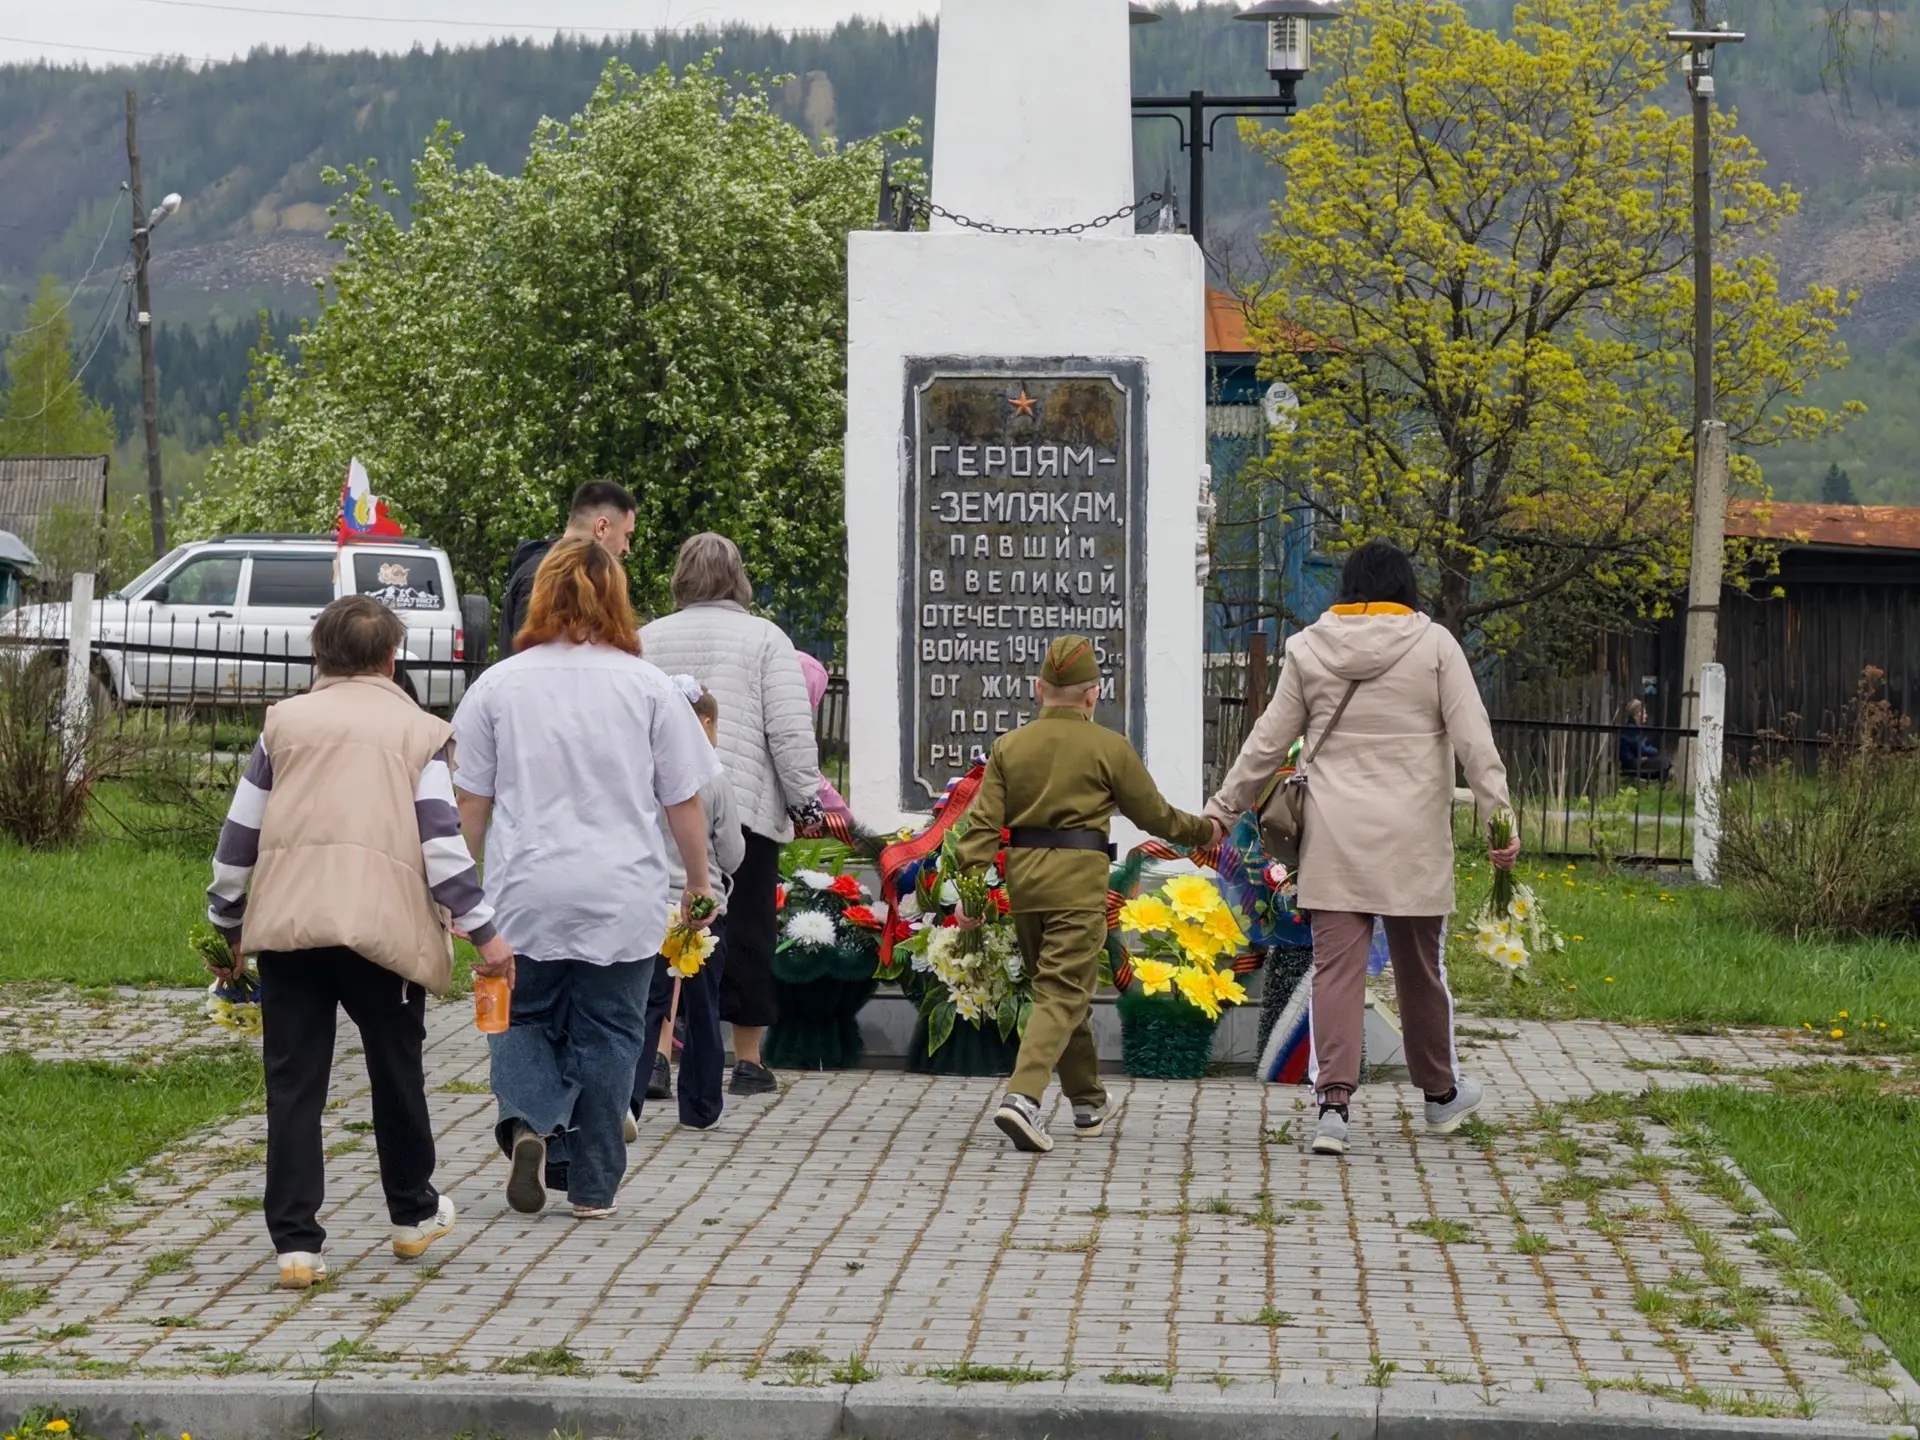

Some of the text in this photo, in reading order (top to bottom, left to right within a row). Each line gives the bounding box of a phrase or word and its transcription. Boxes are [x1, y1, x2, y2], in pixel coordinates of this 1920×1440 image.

[930, 445, 1116, 477] ГЕРОЯМ-
[930, 491, 1124, 528] -ЗЕМЛЯКАМ,
[950, 534, 1096, 559] ПАВШИМ
[929, 564, 1116, 595] В ВЕЛИКОЙ
[921, 600, 1124, 630] ОТЕЧЕСТВЕННОЙ
[921, 632, 1000, 663] ВОЙНЕ
[930, 674, 961, 698] ОТ
